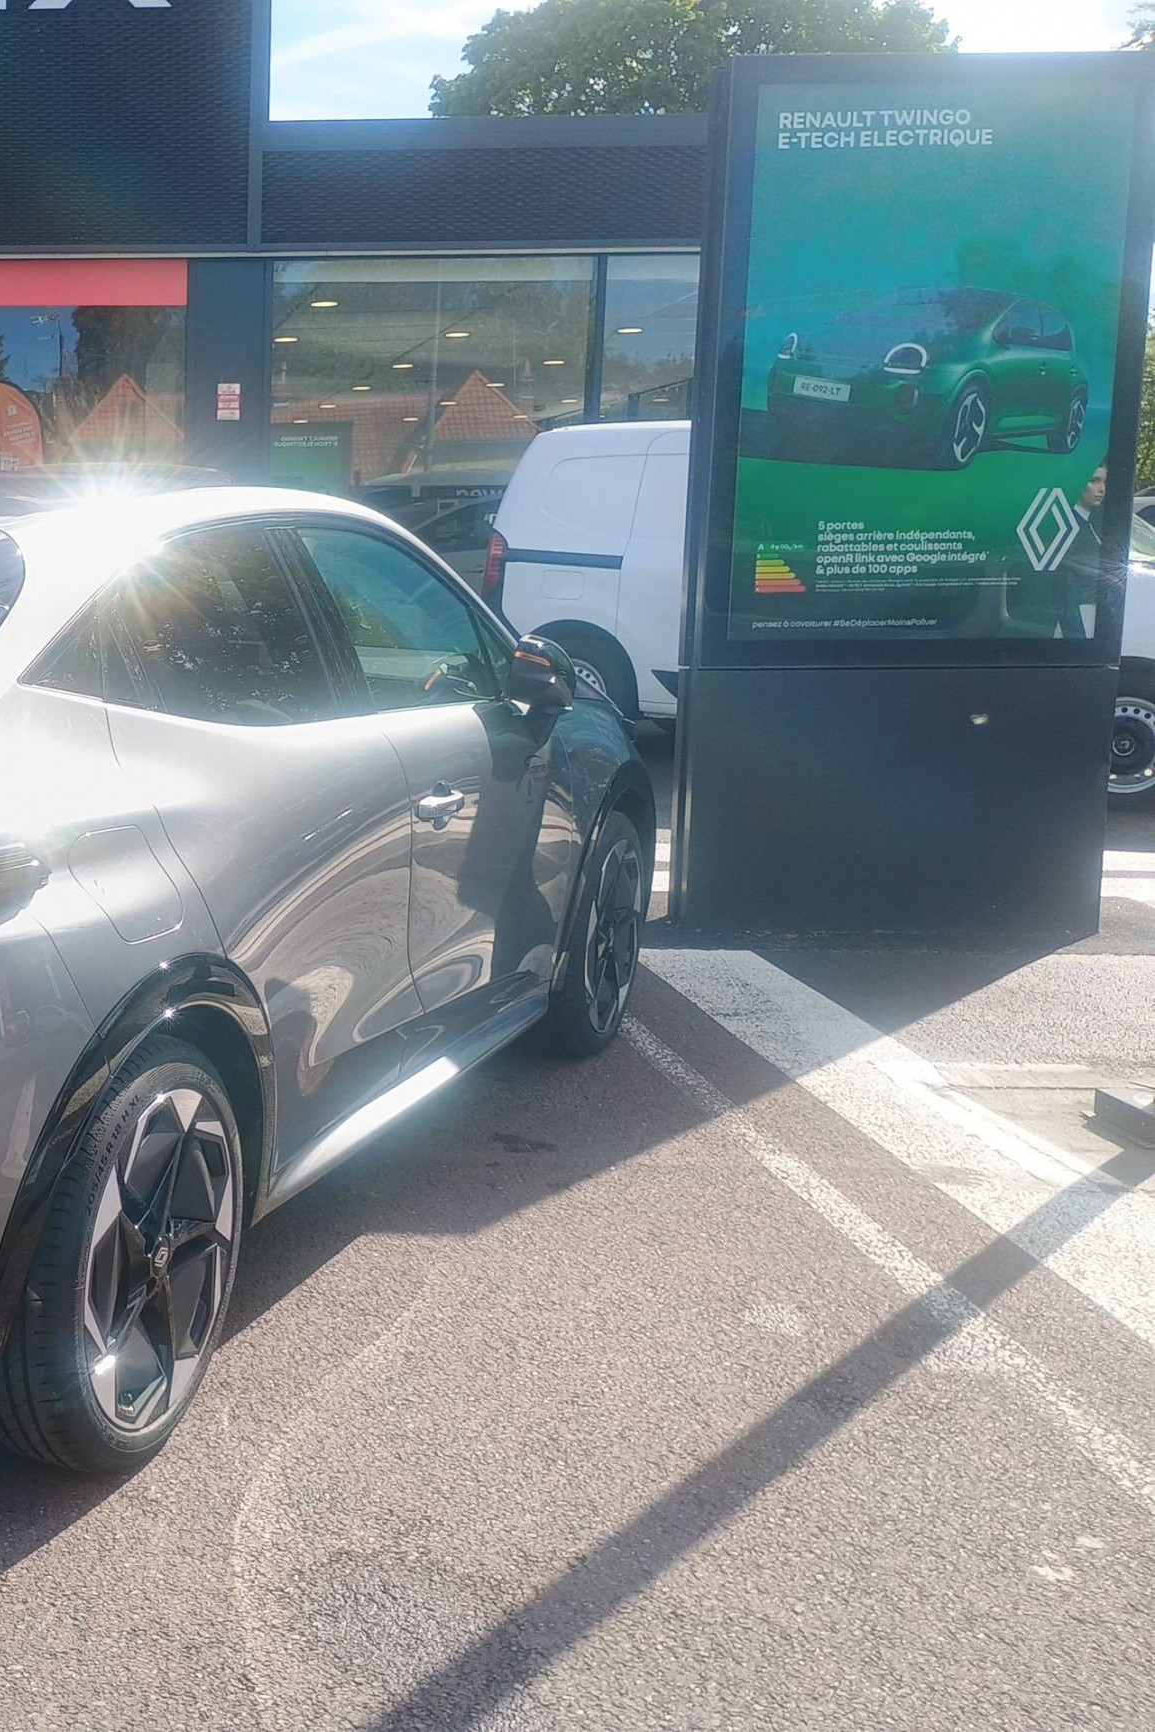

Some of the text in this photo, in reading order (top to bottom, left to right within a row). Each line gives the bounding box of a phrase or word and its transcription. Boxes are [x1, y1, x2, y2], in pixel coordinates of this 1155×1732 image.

[779, 109, 971, 129] RENAULT TWINGO
[778, 129, 994, 149] E-TECH ELECTRIQUE
[818, 521, 865, 532] 5 portes
[817, 529, 976, 543] sièges arrière indépendants,
[816, 541, 963, 553] rabattables et coulissants
[816, 553, 854, 565] openR
[855, 552, 875, 563] link
[876, 554, 905, 563] avec
[906, 552, 947, 564] Google
[816, 563, 918, 576] & plus de 100 apps
[752, 620, 782, 629] pensez
